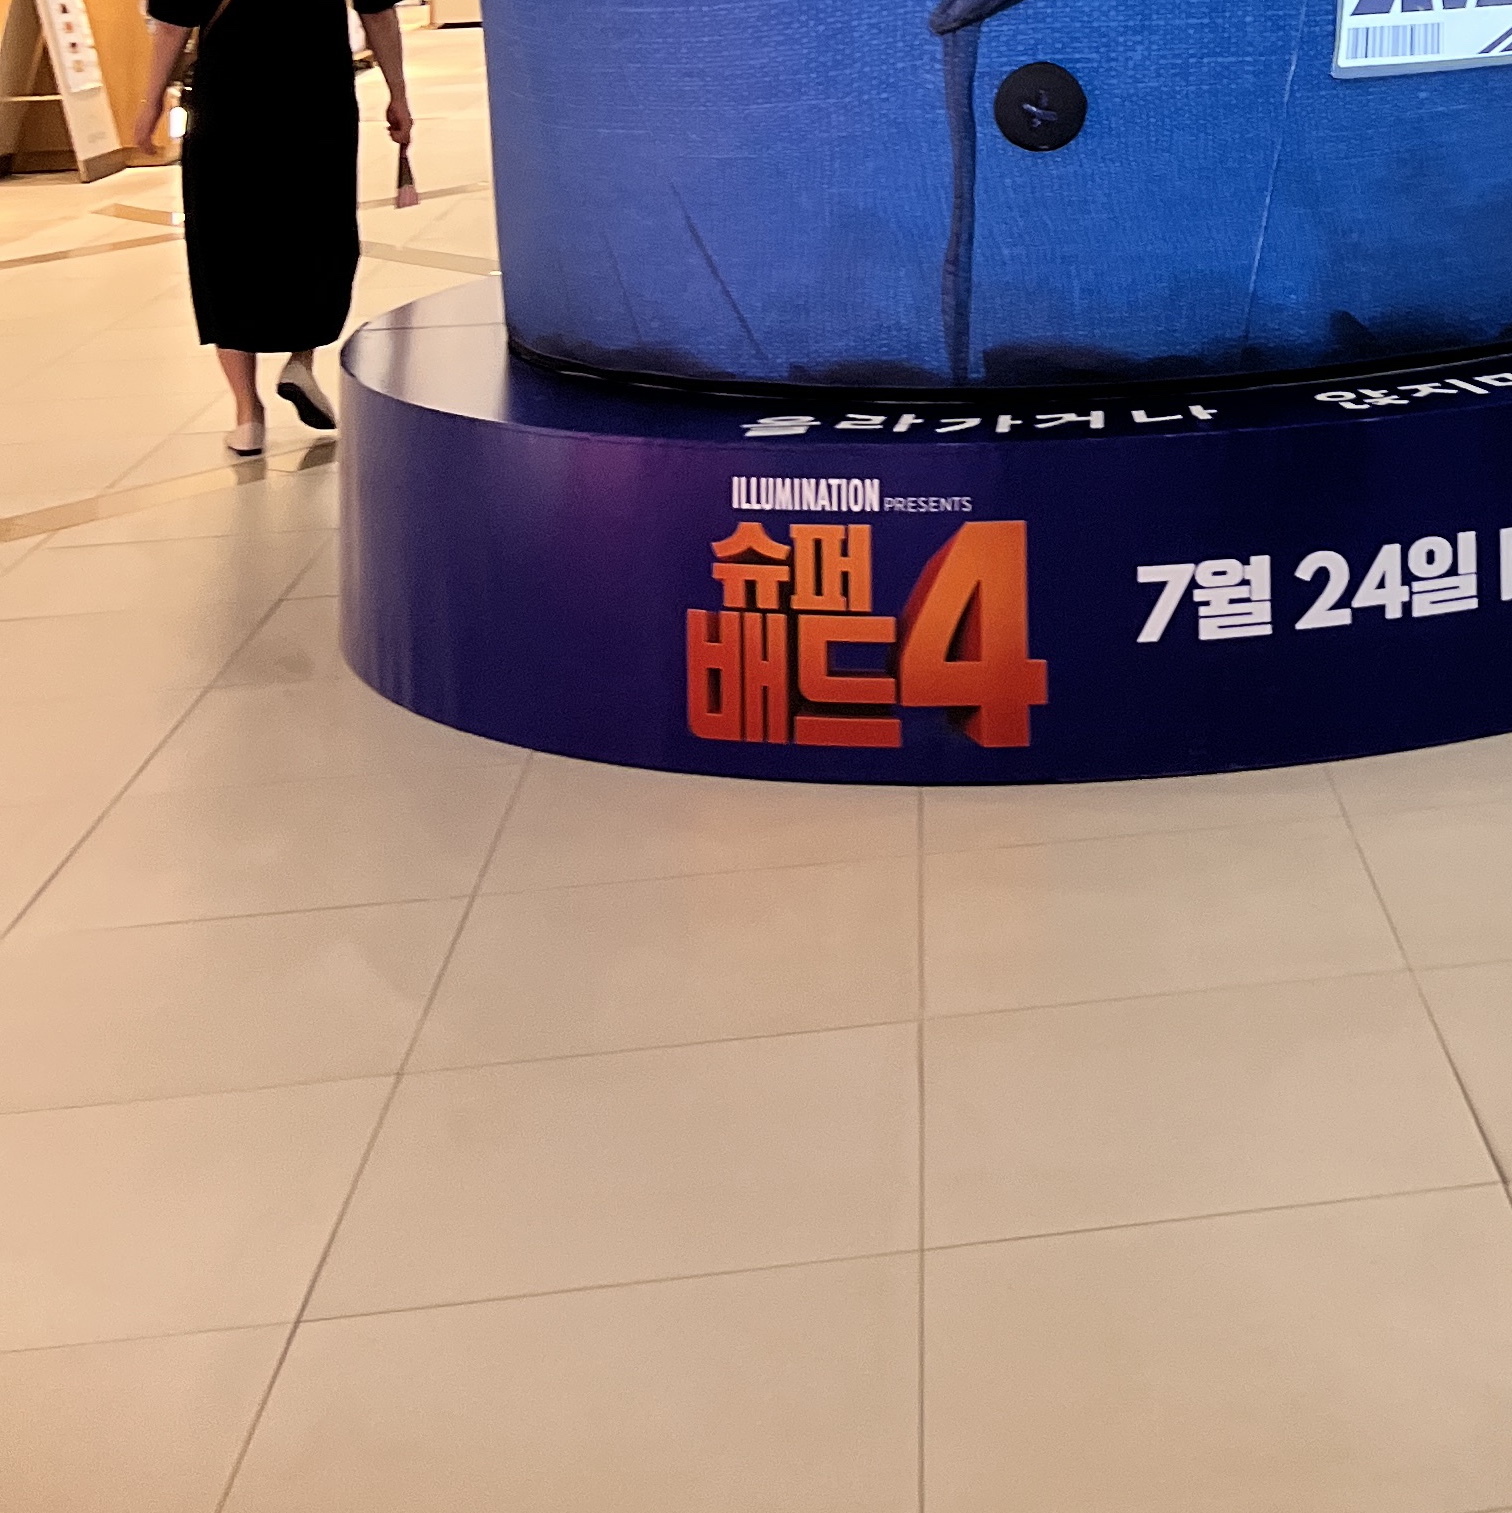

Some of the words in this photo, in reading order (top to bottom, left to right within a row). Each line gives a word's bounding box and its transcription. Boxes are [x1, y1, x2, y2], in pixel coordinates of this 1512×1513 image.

[740, 404, 1218, 437] 올라가거나
[732, 476, 881, 513] ILLUMINATION
[883, 496, 973, 513] PRESENTS
[711, 521, 872, 613] 슈퍼
[1136, 554, 1273, 643] 7월
[1294, 530, 1479, 630] 24일
[899, 519, 1048, 749] 4
